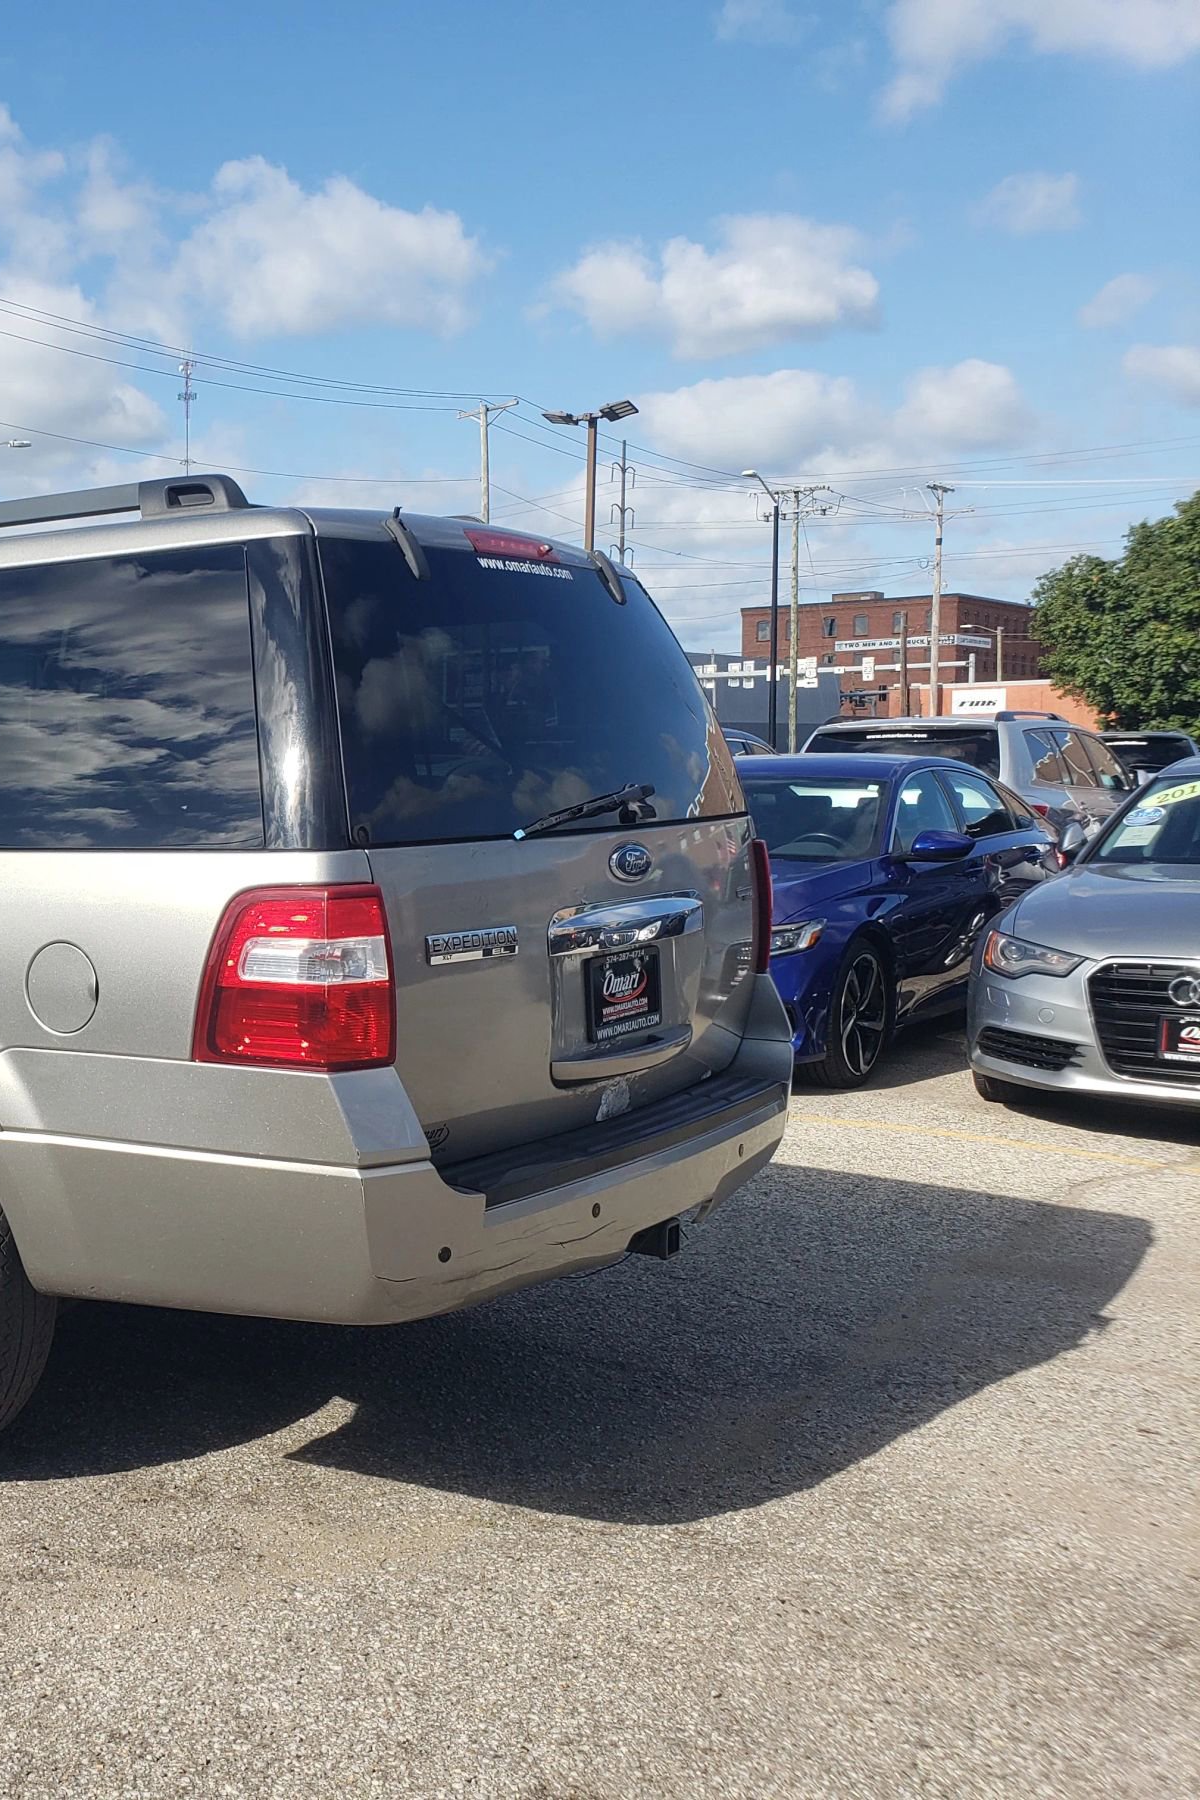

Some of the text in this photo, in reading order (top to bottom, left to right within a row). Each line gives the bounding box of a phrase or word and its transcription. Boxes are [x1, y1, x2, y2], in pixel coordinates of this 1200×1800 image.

[477, 557, 574, 581] www.omariauto.com
[625, 851, 647, 873] Ford
[432, 929, 517, 953] EXPEDITION
[492, 947, 511, 955] EL
[596, 1014, 660, 1040] WWW.OMARIAUTO.COM
